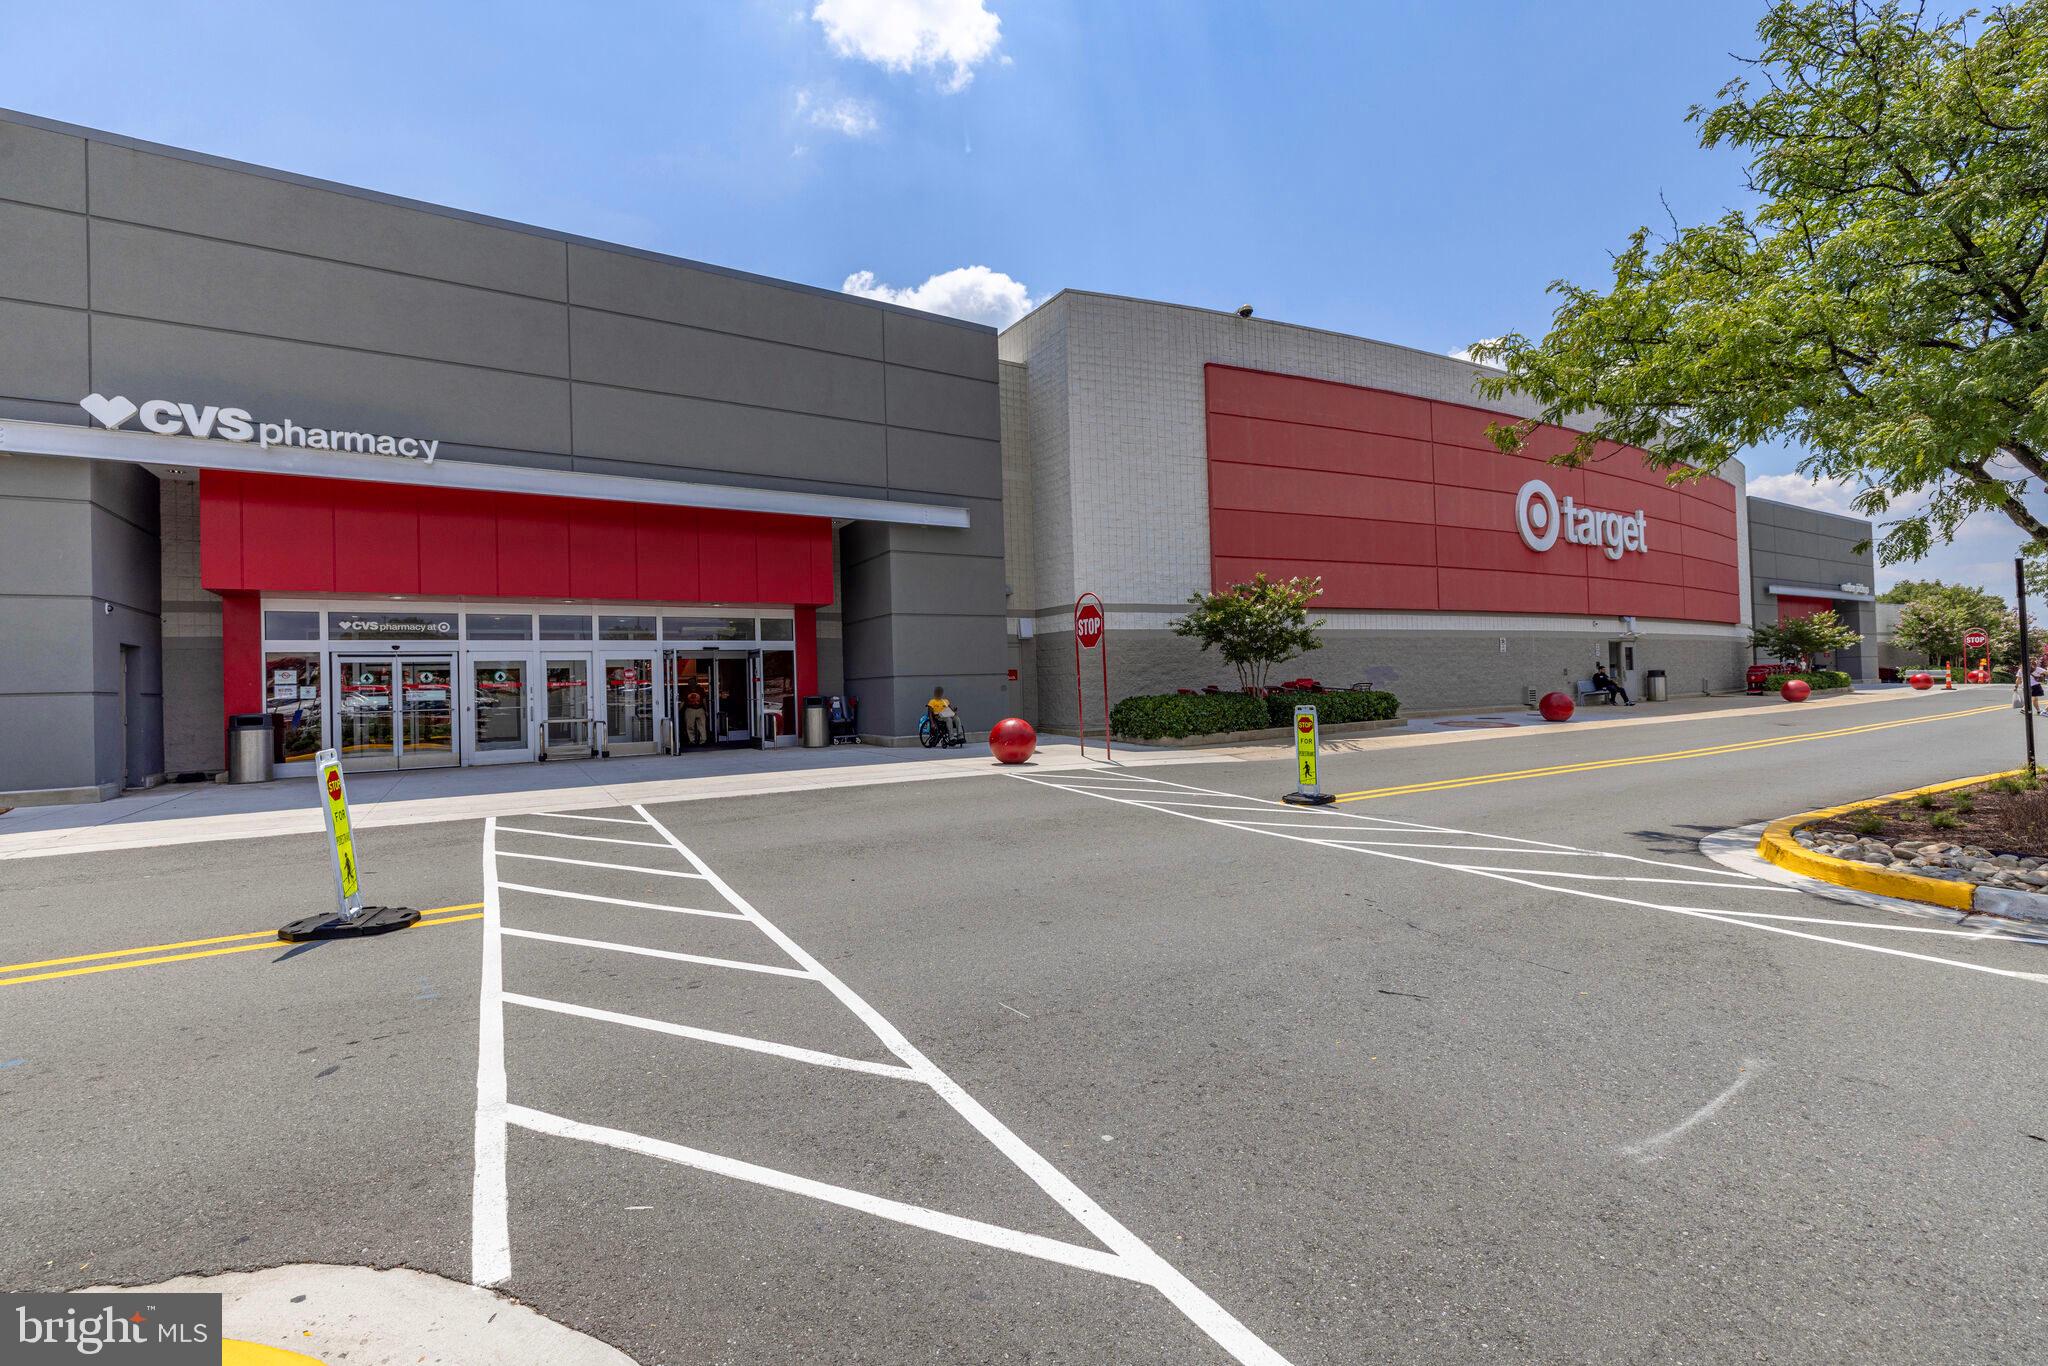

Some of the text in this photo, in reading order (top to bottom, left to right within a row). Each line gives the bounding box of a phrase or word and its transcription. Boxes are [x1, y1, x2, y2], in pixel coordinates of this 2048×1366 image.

[139, 400, 440, 464] CVS pharmacy
[1560, 495, 1648, 560] target
[352, 621, 436, 632] CVS pharmacy at
[1078, 617, 1101, 636] STOP
[1966, 636, 1985, 644] STOP
[328, 779, 341, 792] STOP
[334, 810, 346, 822] FOR
